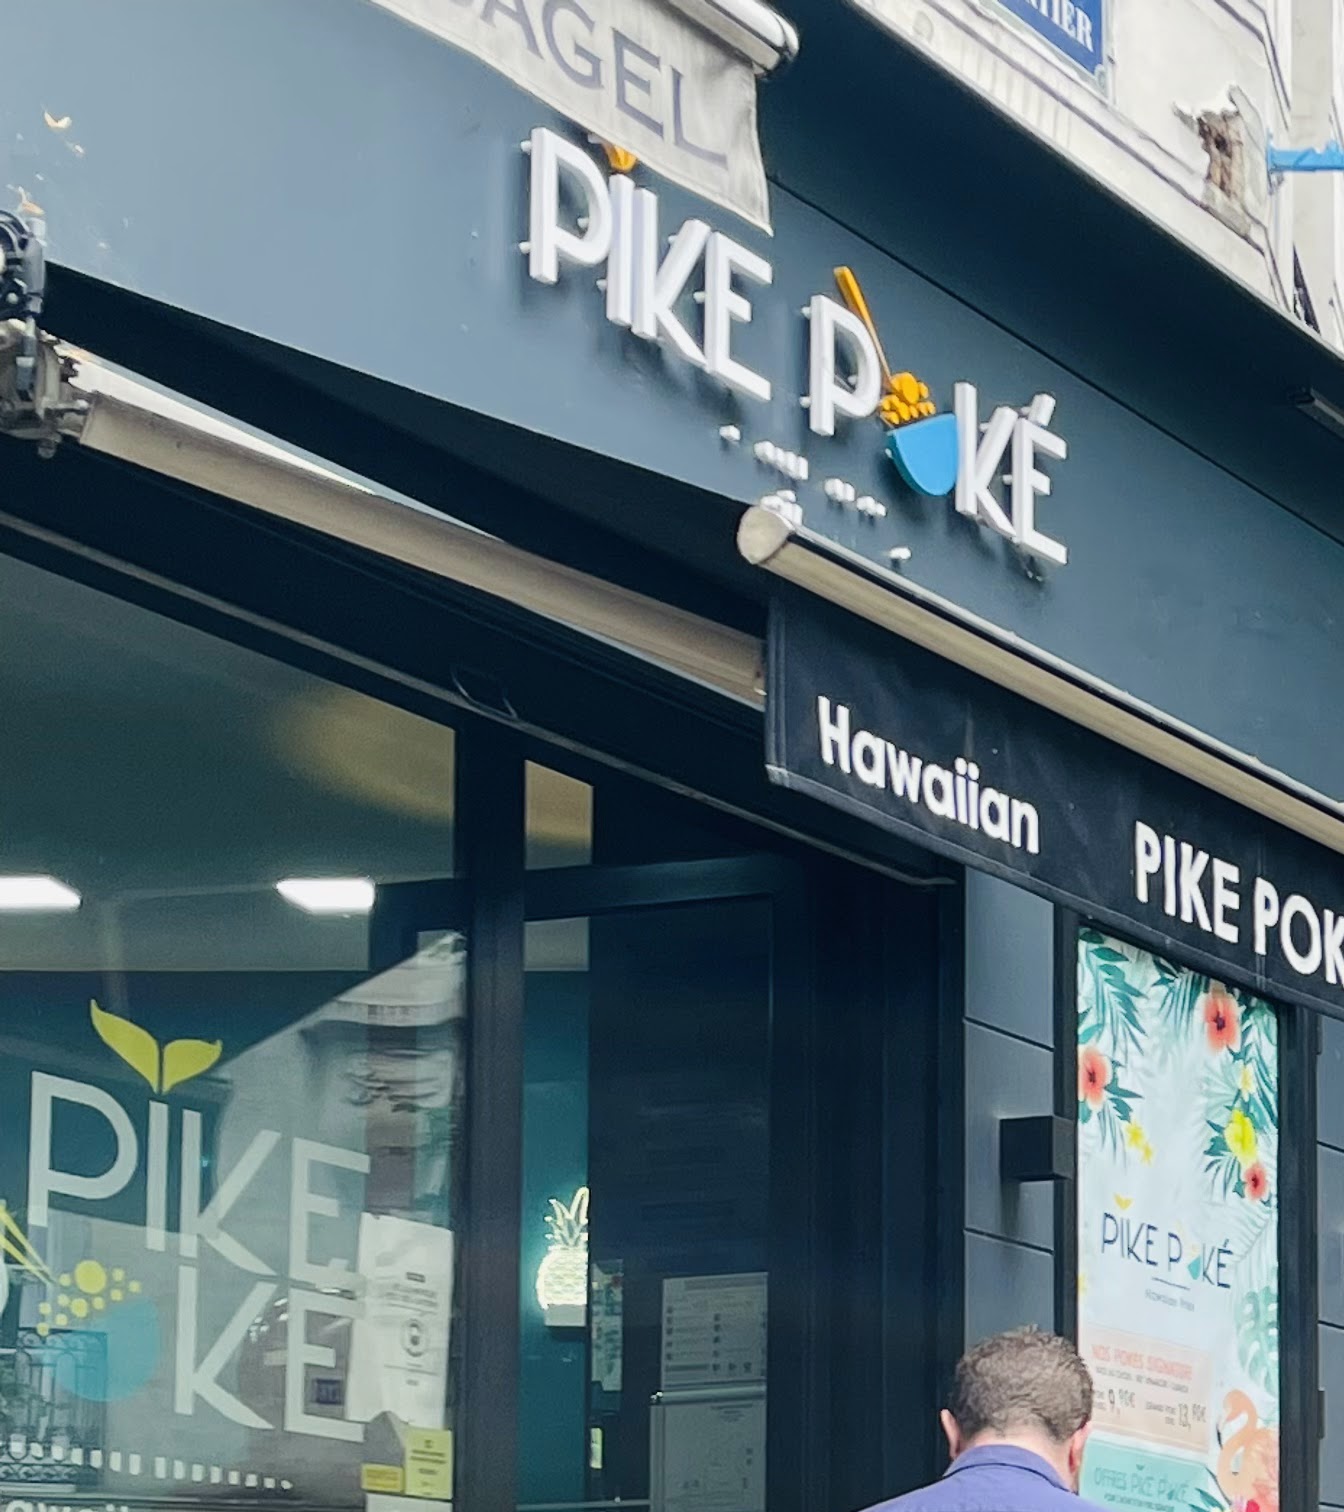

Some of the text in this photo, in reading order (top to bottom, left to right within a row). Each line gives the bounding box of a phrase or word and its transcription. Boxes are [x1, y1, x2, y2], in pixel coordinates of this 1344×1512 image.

[450, 0, 728, 171] AGEL
[529, 127, 772, 401] PIKE
[816, 696, 1040, 855] Hawaiian
[1134, 821, 1241, 944] PIKE
[28, 1071, 371, 1288] PIKE
[1101, 1212, 1158, 1266] PIKE
